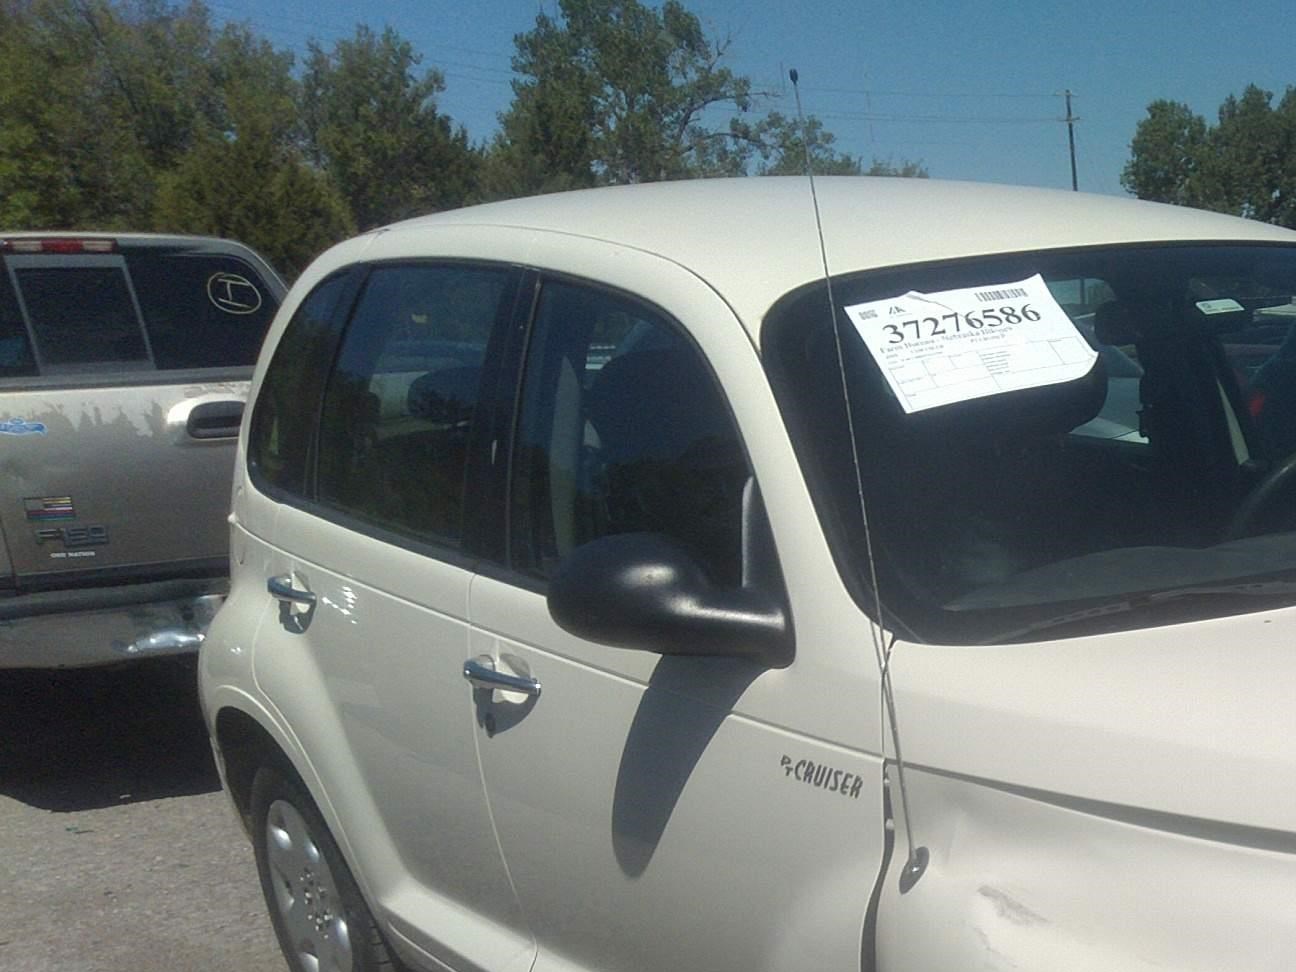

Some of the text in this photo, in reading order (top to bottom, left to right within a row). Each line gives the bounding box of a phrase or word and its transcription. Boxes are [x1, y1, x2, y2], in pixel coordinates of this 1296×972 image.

[882, 303, 1041, 344] 37276586
[780, 755, 863, 798] PT CRUISER
